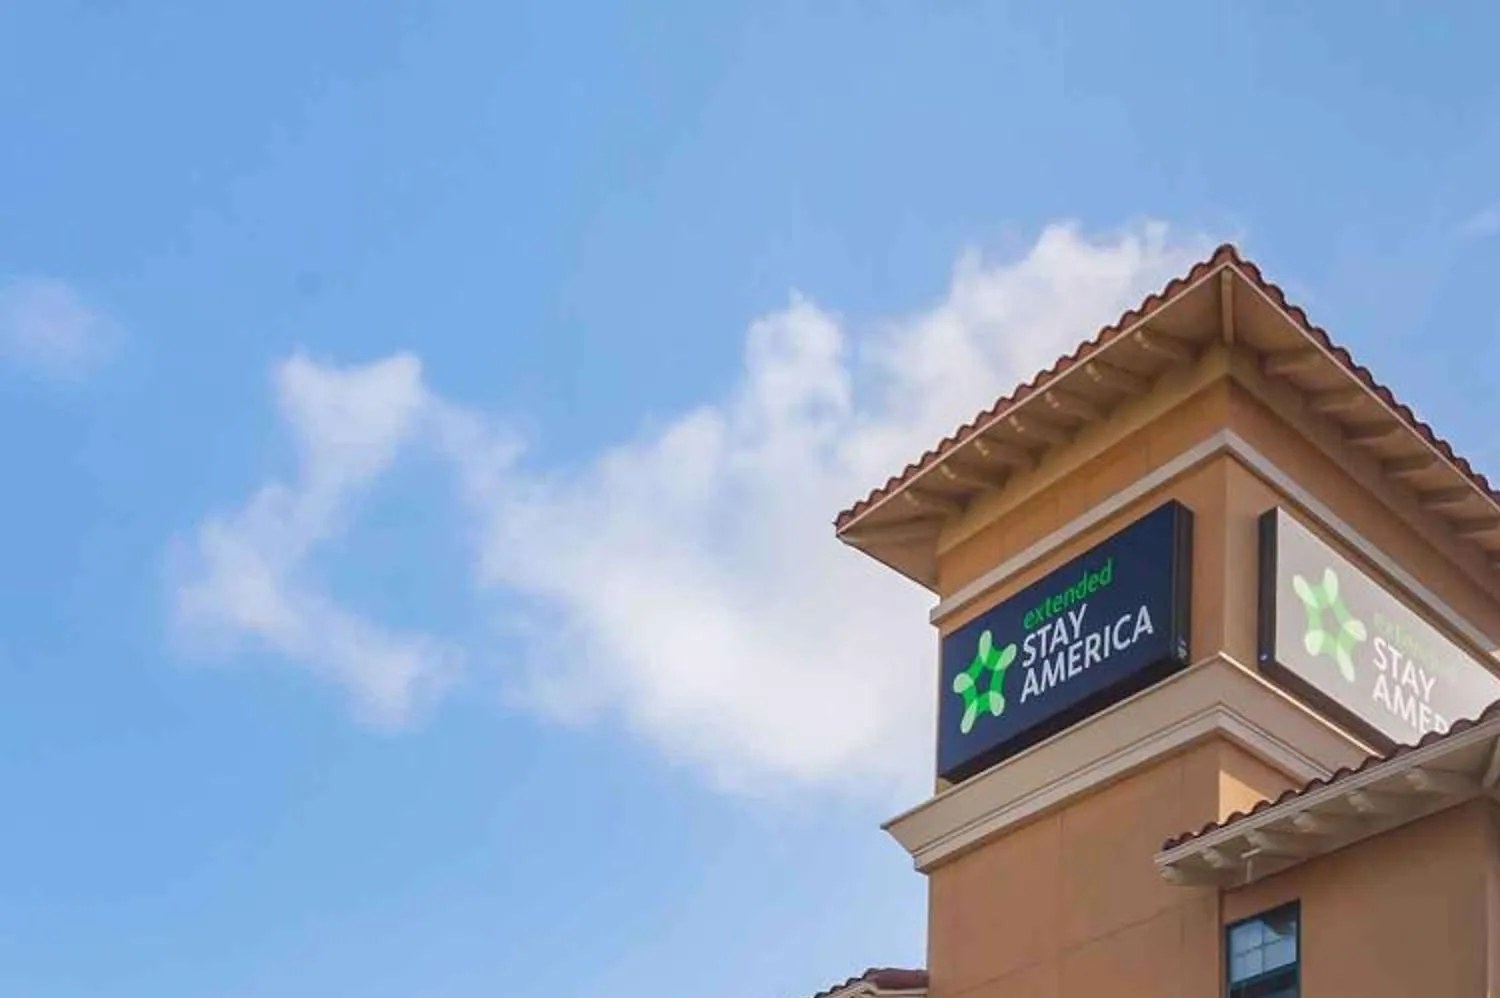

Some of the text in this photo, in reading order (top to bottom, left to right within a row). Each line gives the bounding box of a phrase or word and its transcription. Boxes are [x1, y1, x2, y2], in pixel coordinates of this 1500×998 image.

[1023, 557, 1113, 630] extended
[1019, 604, 1154, 704] AMERICA
[1022, 603, 1087, 667] STAY
[1372, 637, 1437, 703] STAY
